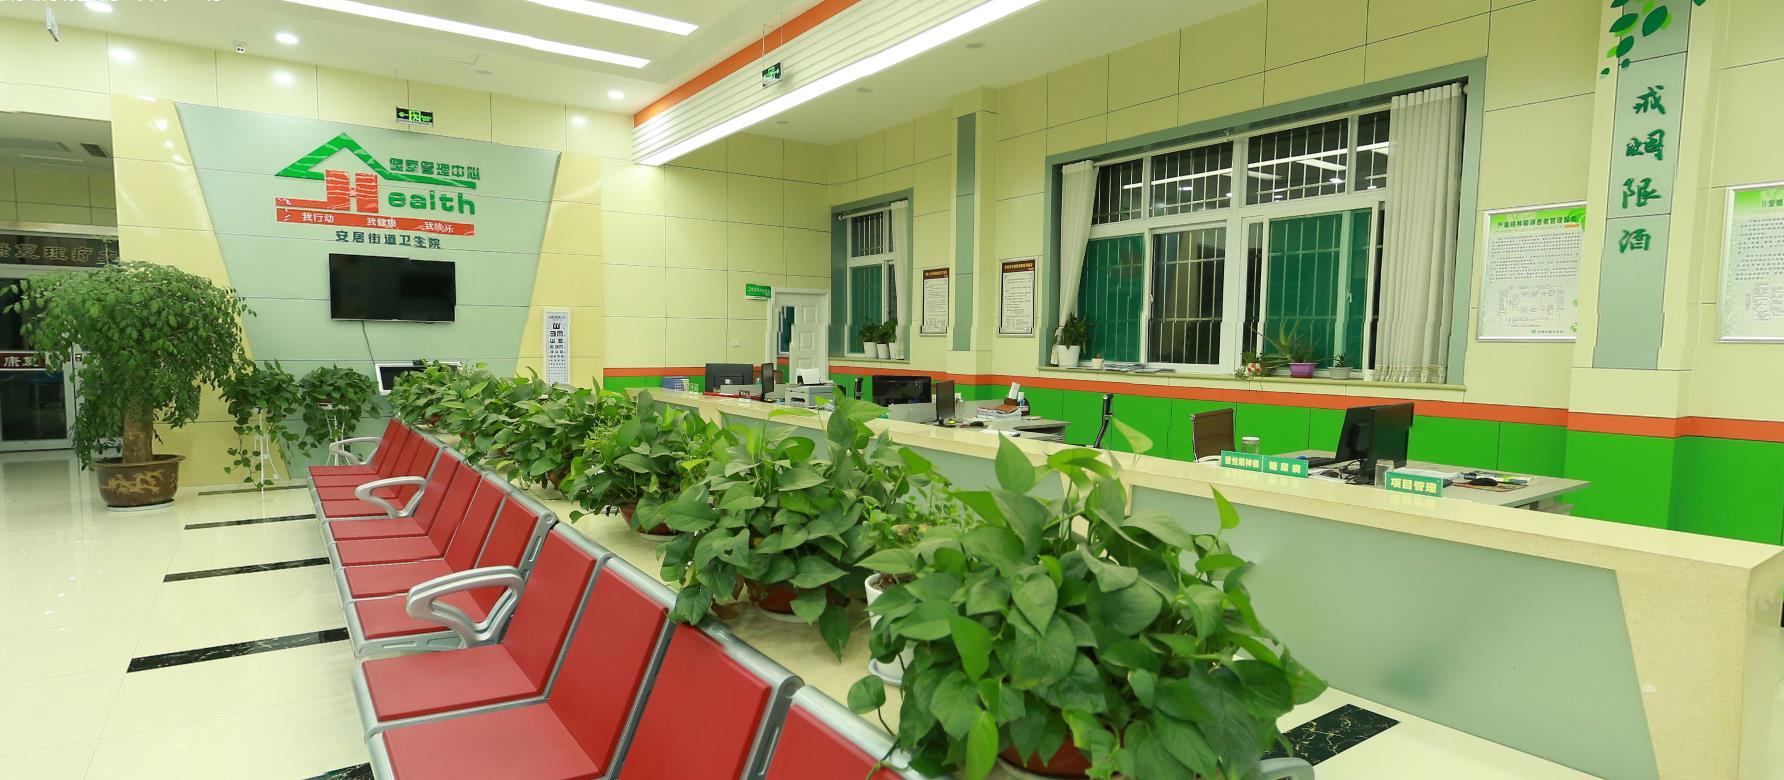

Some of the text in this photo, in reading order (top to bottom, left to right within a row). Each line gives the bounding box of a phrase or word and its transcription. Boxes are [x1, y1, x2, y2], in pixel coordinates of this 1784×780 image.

[302, 211, 454, 234] 我行动 我健康 我快乐
[335, 230, 441, 249] 安居街道卫生院
[1391, 477, 1437, 493] 项目管理
